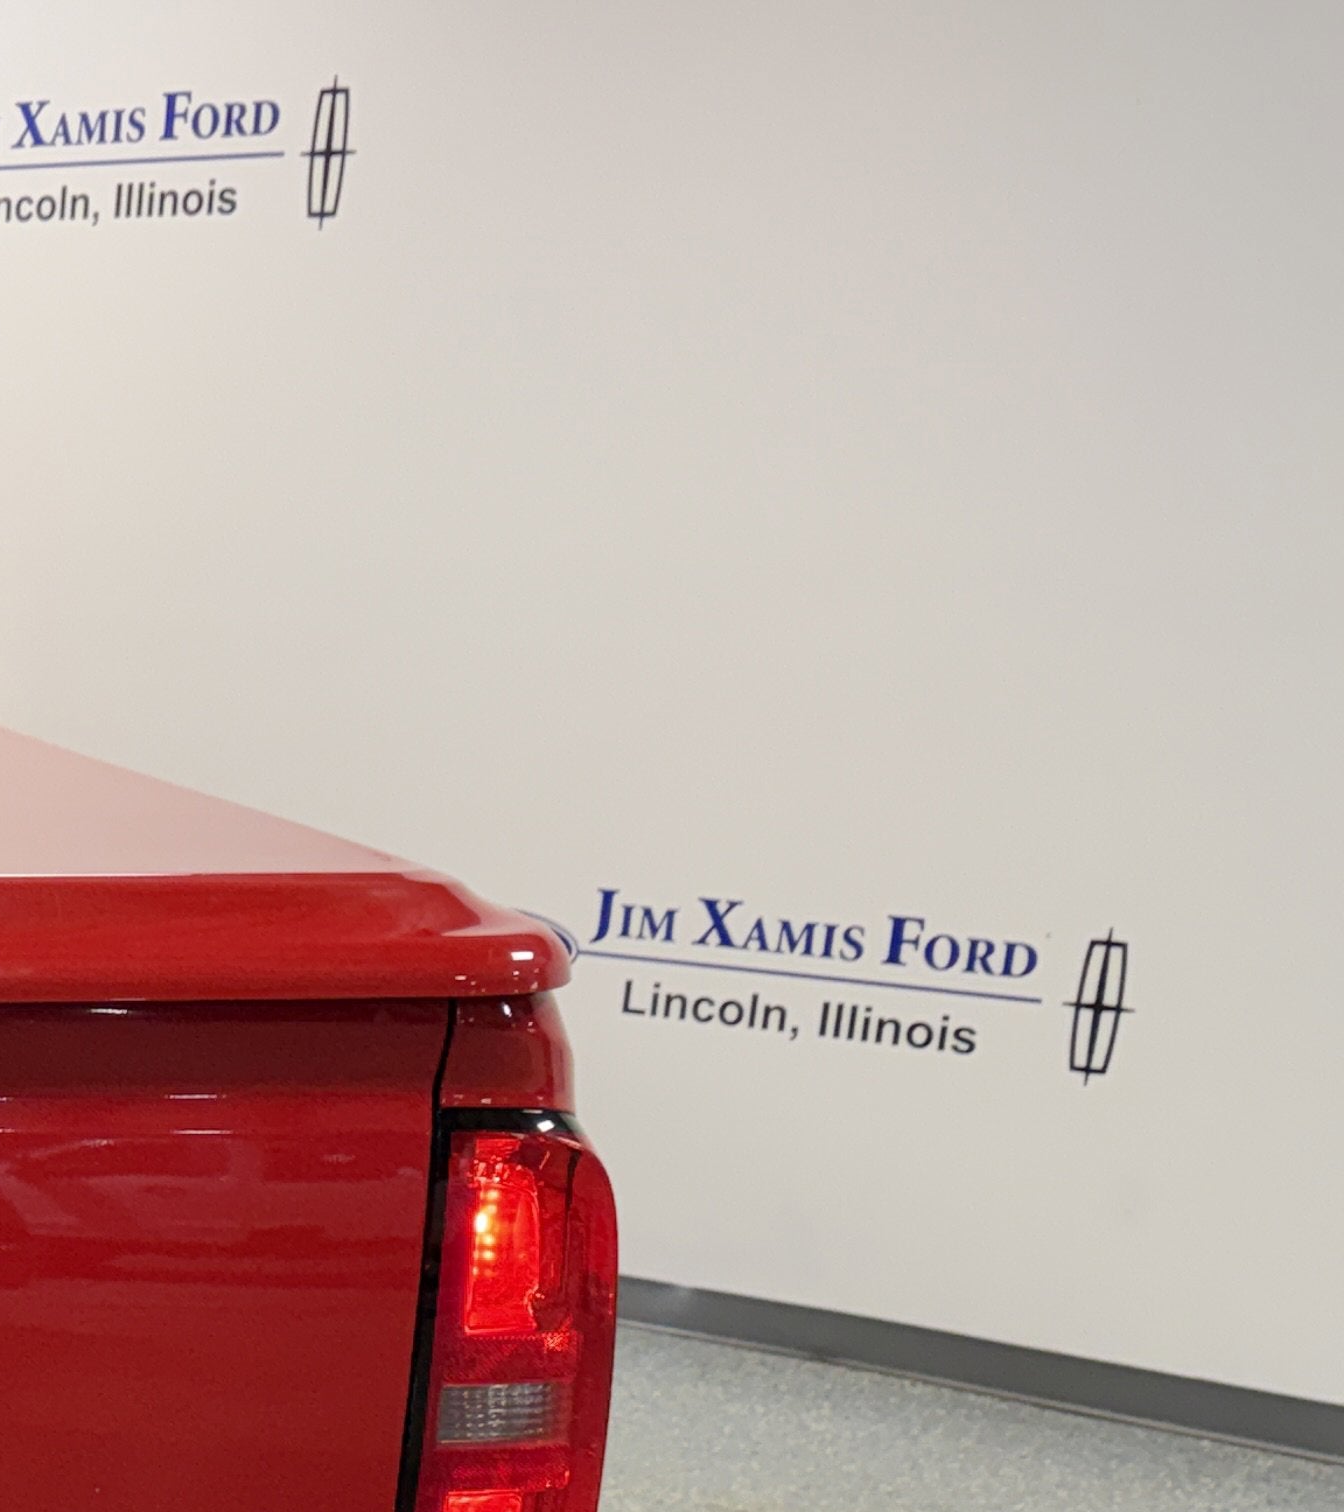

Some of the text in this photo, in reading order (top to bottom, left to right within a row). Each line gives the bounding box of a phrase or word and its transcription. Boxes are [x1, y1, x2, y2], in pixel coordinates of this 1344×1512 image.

[114, 178, 238, 219] Illinois
[620, 979, 978, 1055] Lincoln, Illinois
